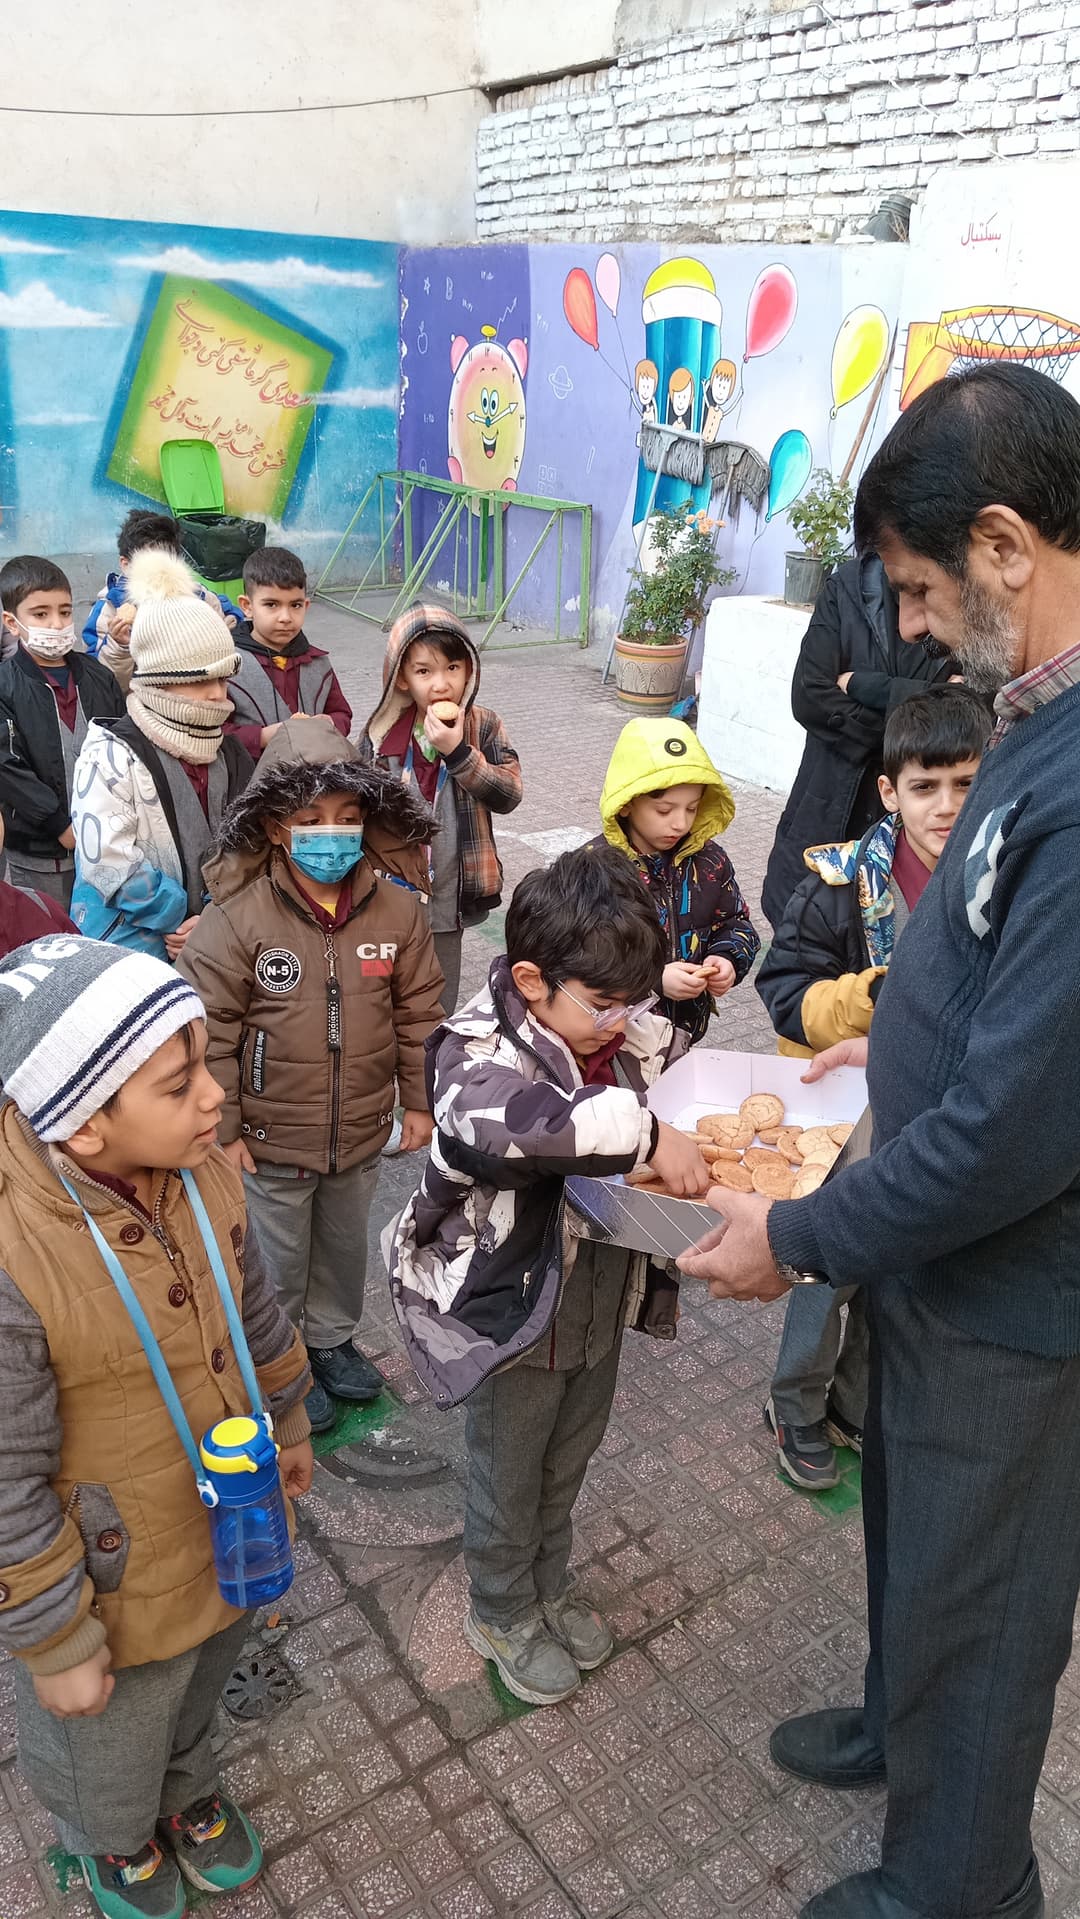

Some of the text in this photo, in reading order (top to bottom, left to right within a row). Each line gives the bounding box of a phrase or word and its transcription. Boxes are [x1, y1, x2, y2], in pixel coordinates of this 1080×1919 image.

[961, 212, 1002, 253] بسکتبال
[216, 343, 264, 381] عاشقی
[146, 384, 176, 409] محمد
[258, 379, 313, 409] سعدی
[248, 448, 287, 477] عشق
[266, 965, 290, 976] N-5
